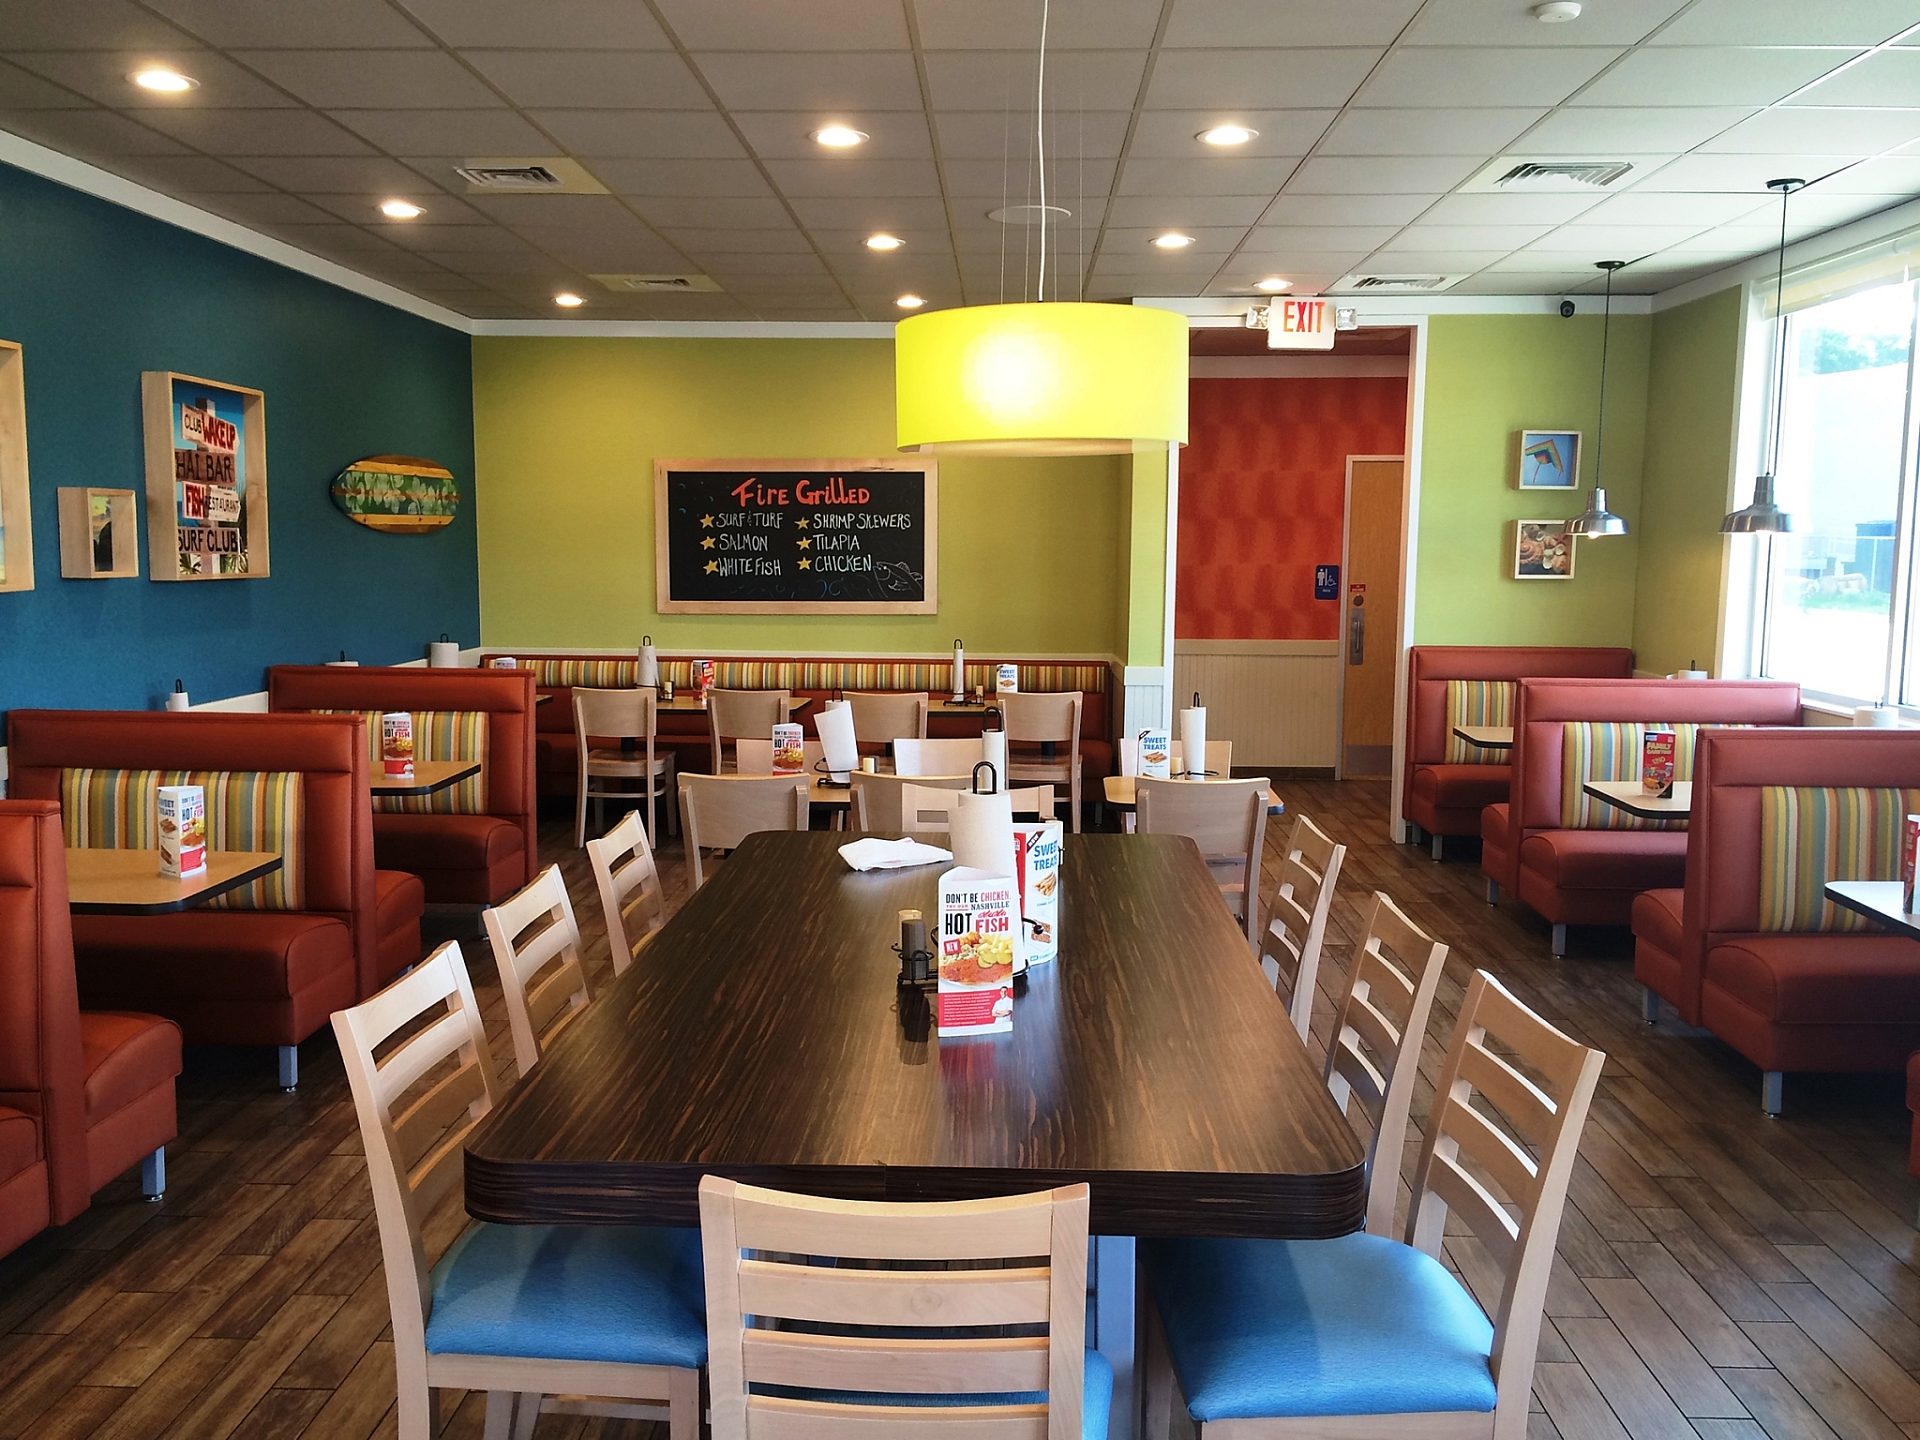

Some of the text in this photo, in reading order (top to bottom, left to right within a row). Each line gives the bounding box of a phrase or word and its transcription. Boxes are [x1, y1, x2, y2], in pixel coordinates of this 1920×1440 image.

[1283, 301, 1325, 333] EXIT
[206, 454, 233, 483] BAR
[186, 483, 204, 517] FISH
[716, 512, 746, 528] SURF
[753, 512, 784, 529] TURF
[813, 513, 912, 530] SHRIMP SKEWERS
[206, 529, 239, 553] CLUB
[719, 532, 768, 552] SALMON
[812, 533, 860, 551] TILAPIA
[814, 554, 872, 573] CHICKEN
[945, 893, 968, 904] DON'T
[969, 892, 979, 903] BE
[970, 901, 1010, 911] NASHVILLE
[945, 912, 1009, 936] HOT FISH
